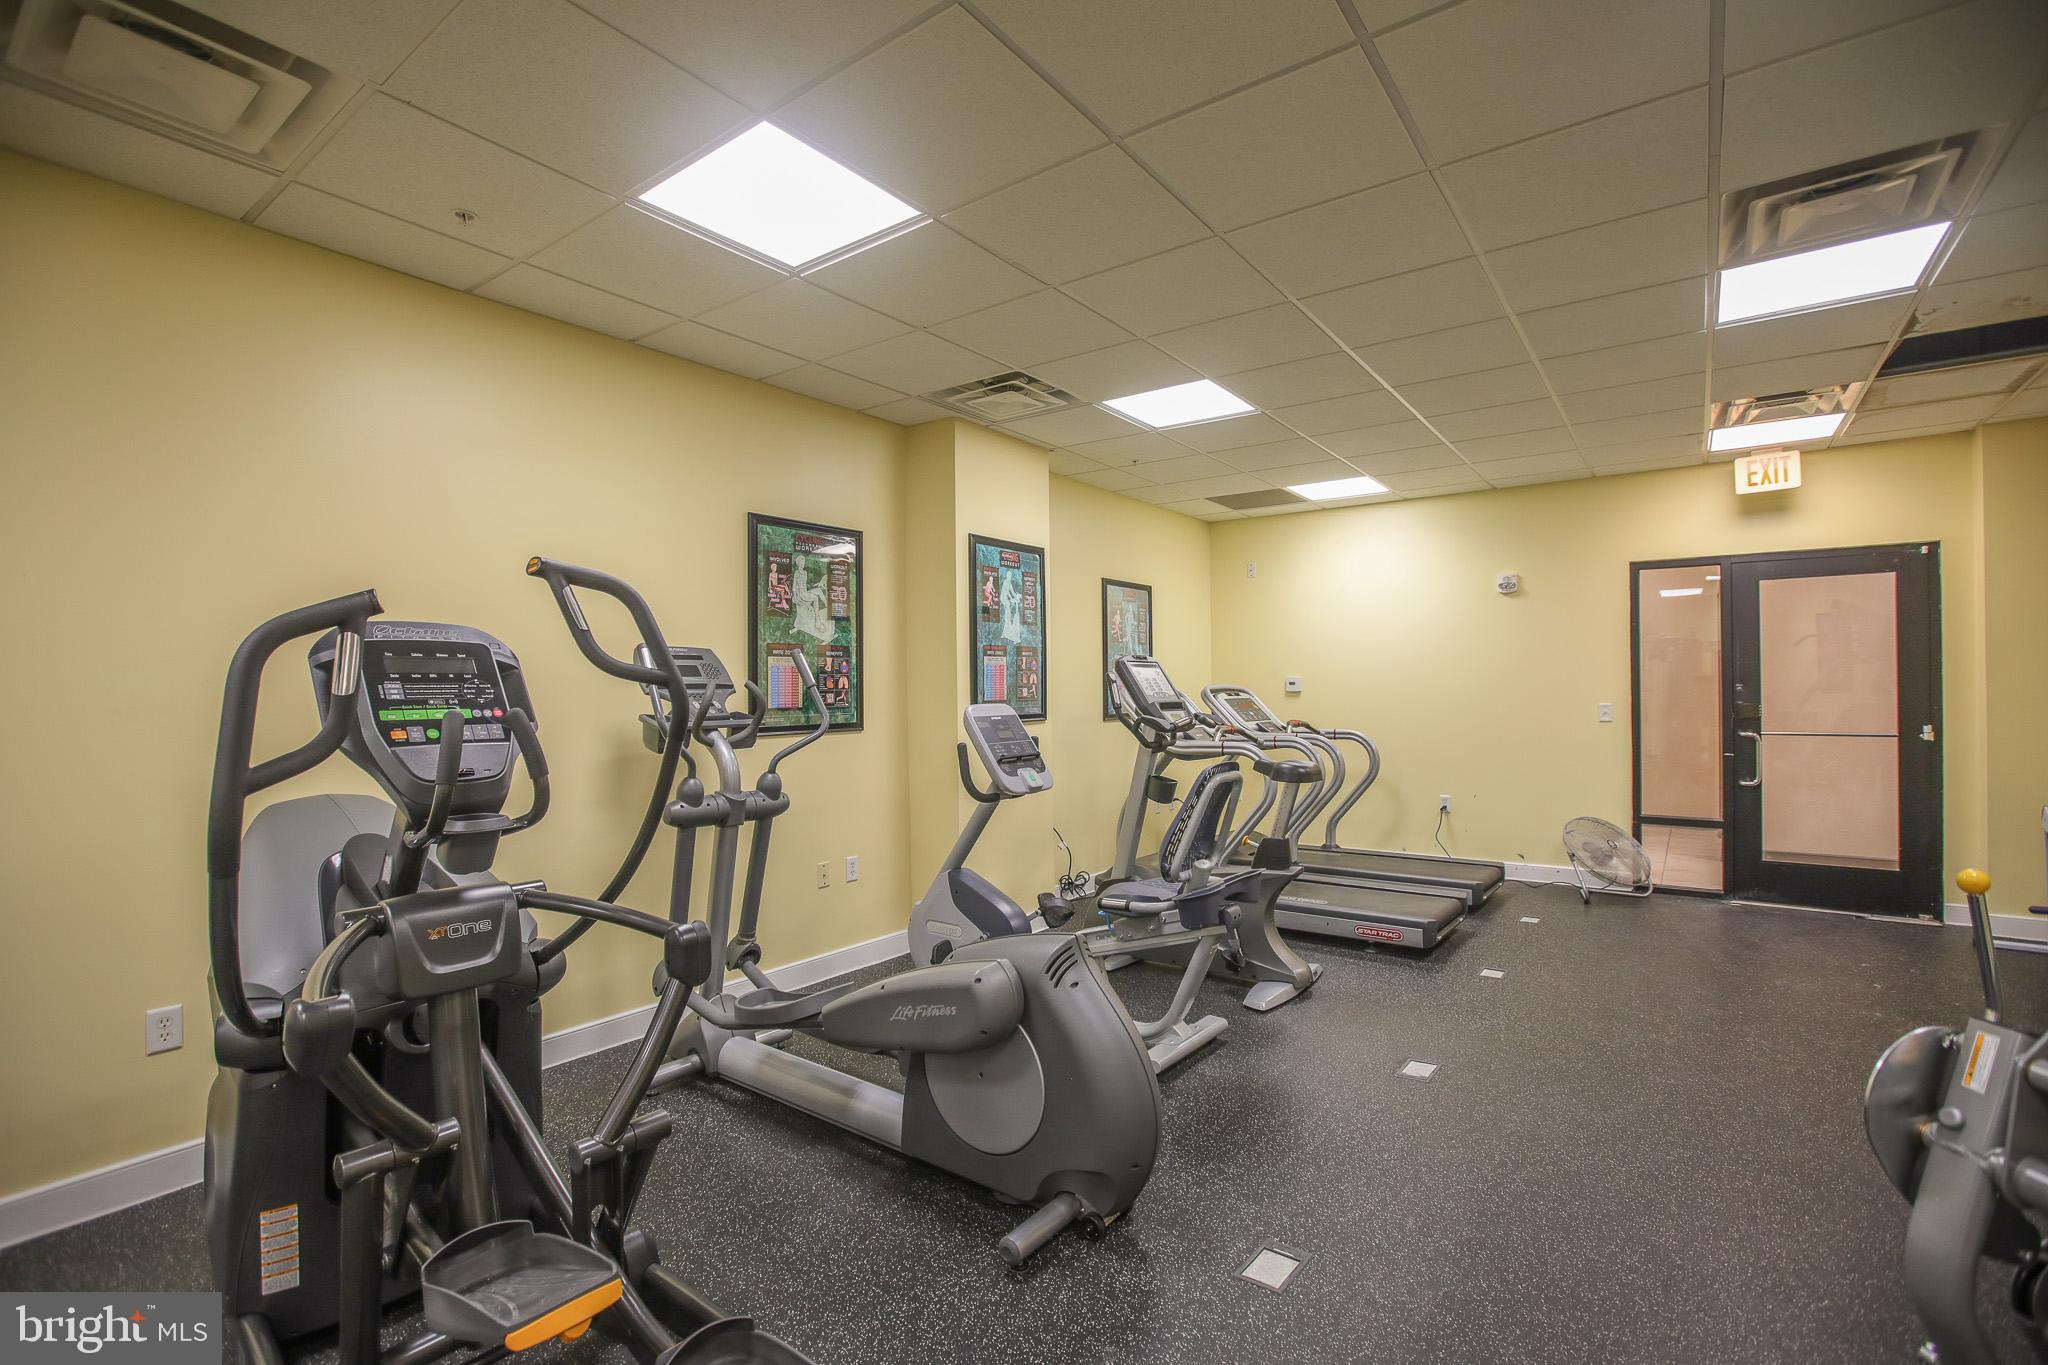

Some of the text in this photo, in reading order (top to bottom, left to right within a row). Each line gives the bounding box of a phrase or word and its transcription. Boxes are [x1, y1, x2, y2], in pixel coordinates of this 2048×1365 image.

[1746, 455, 1791, 487] EXIT
[1357, 928, 1401, 939] STAR TRAC
[889, 1004, 958, 1022] Life Fitness
